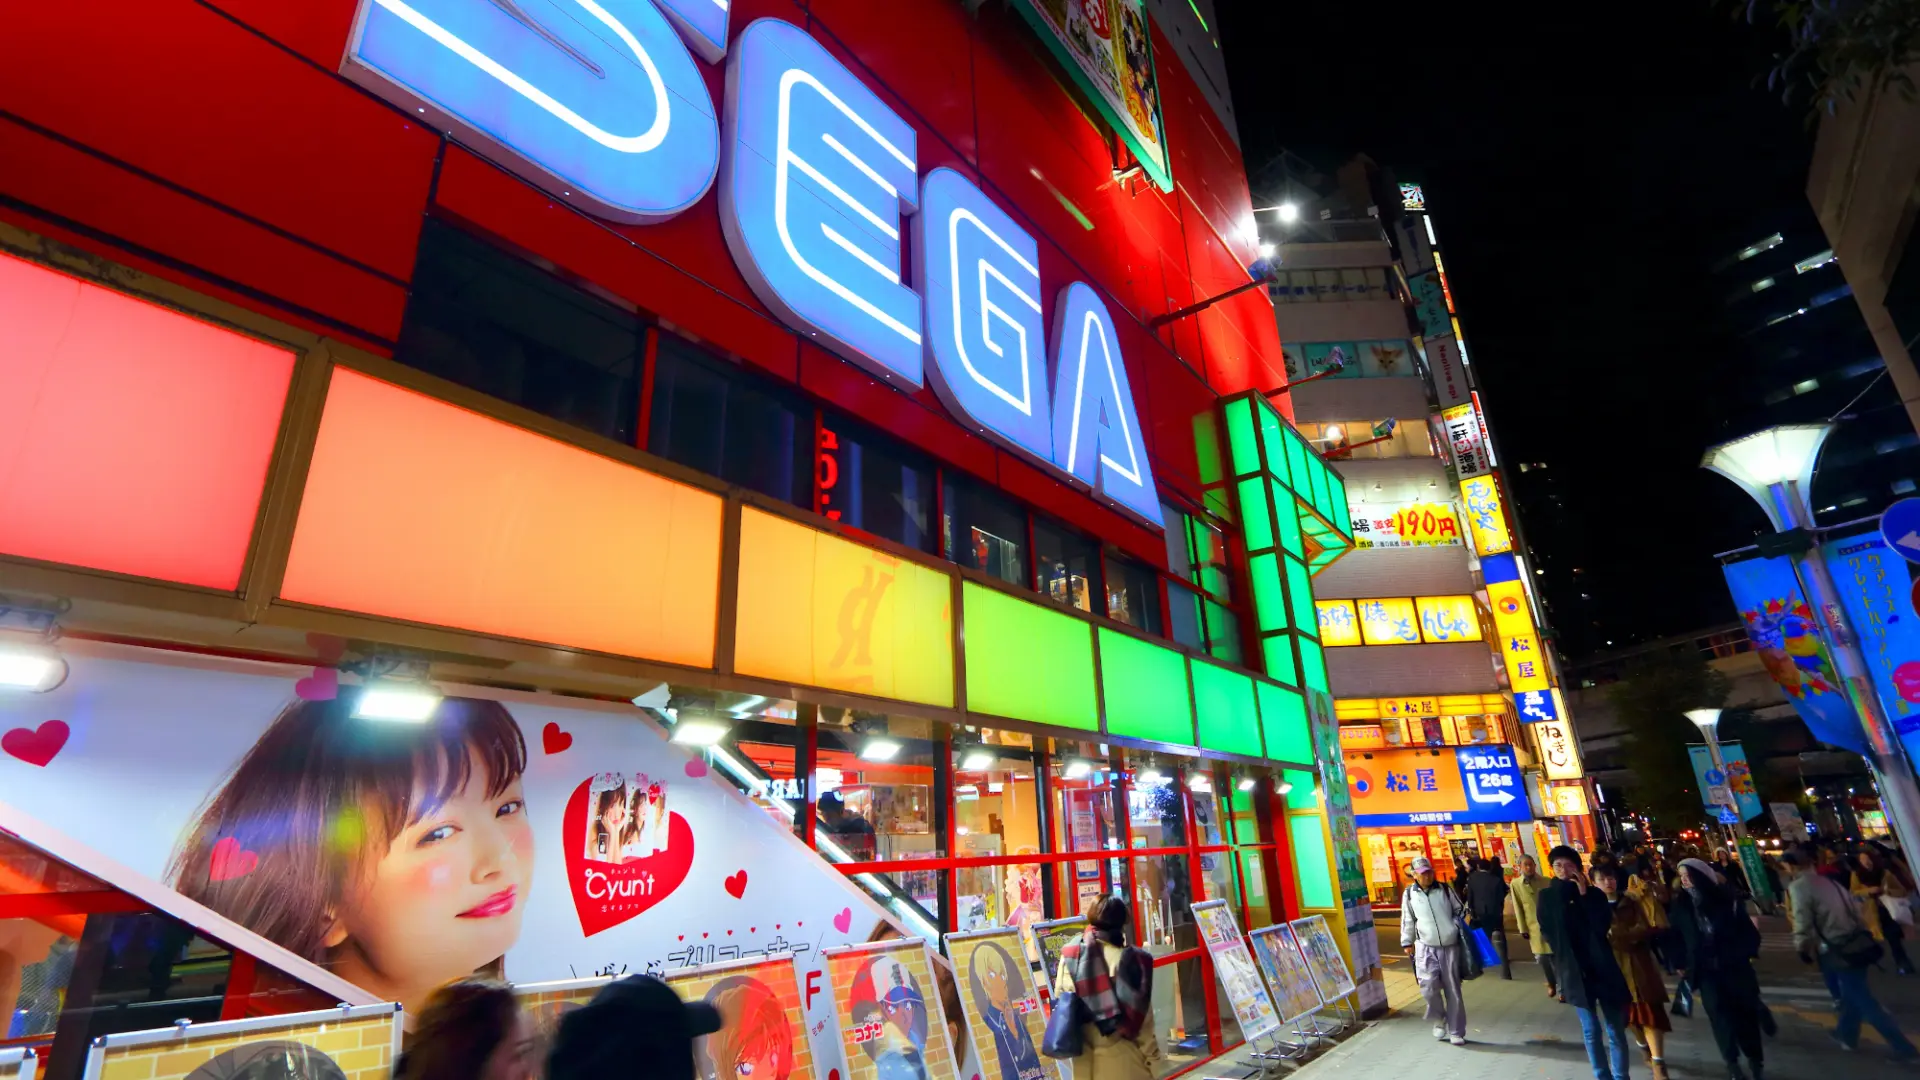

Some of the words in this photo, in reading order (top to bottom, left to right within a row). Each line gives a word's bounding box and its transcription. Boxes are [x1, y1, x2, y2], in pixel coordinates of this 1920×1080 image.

[1397, 510, 1457, 537] 190円
[1510, 637, 1536, 678] 松屋
[1404, 701, 1434, 713] 松屋
[1540, 724, 1568, 767] ねぎし
[1385, 768, 1439, 793] 松屋
